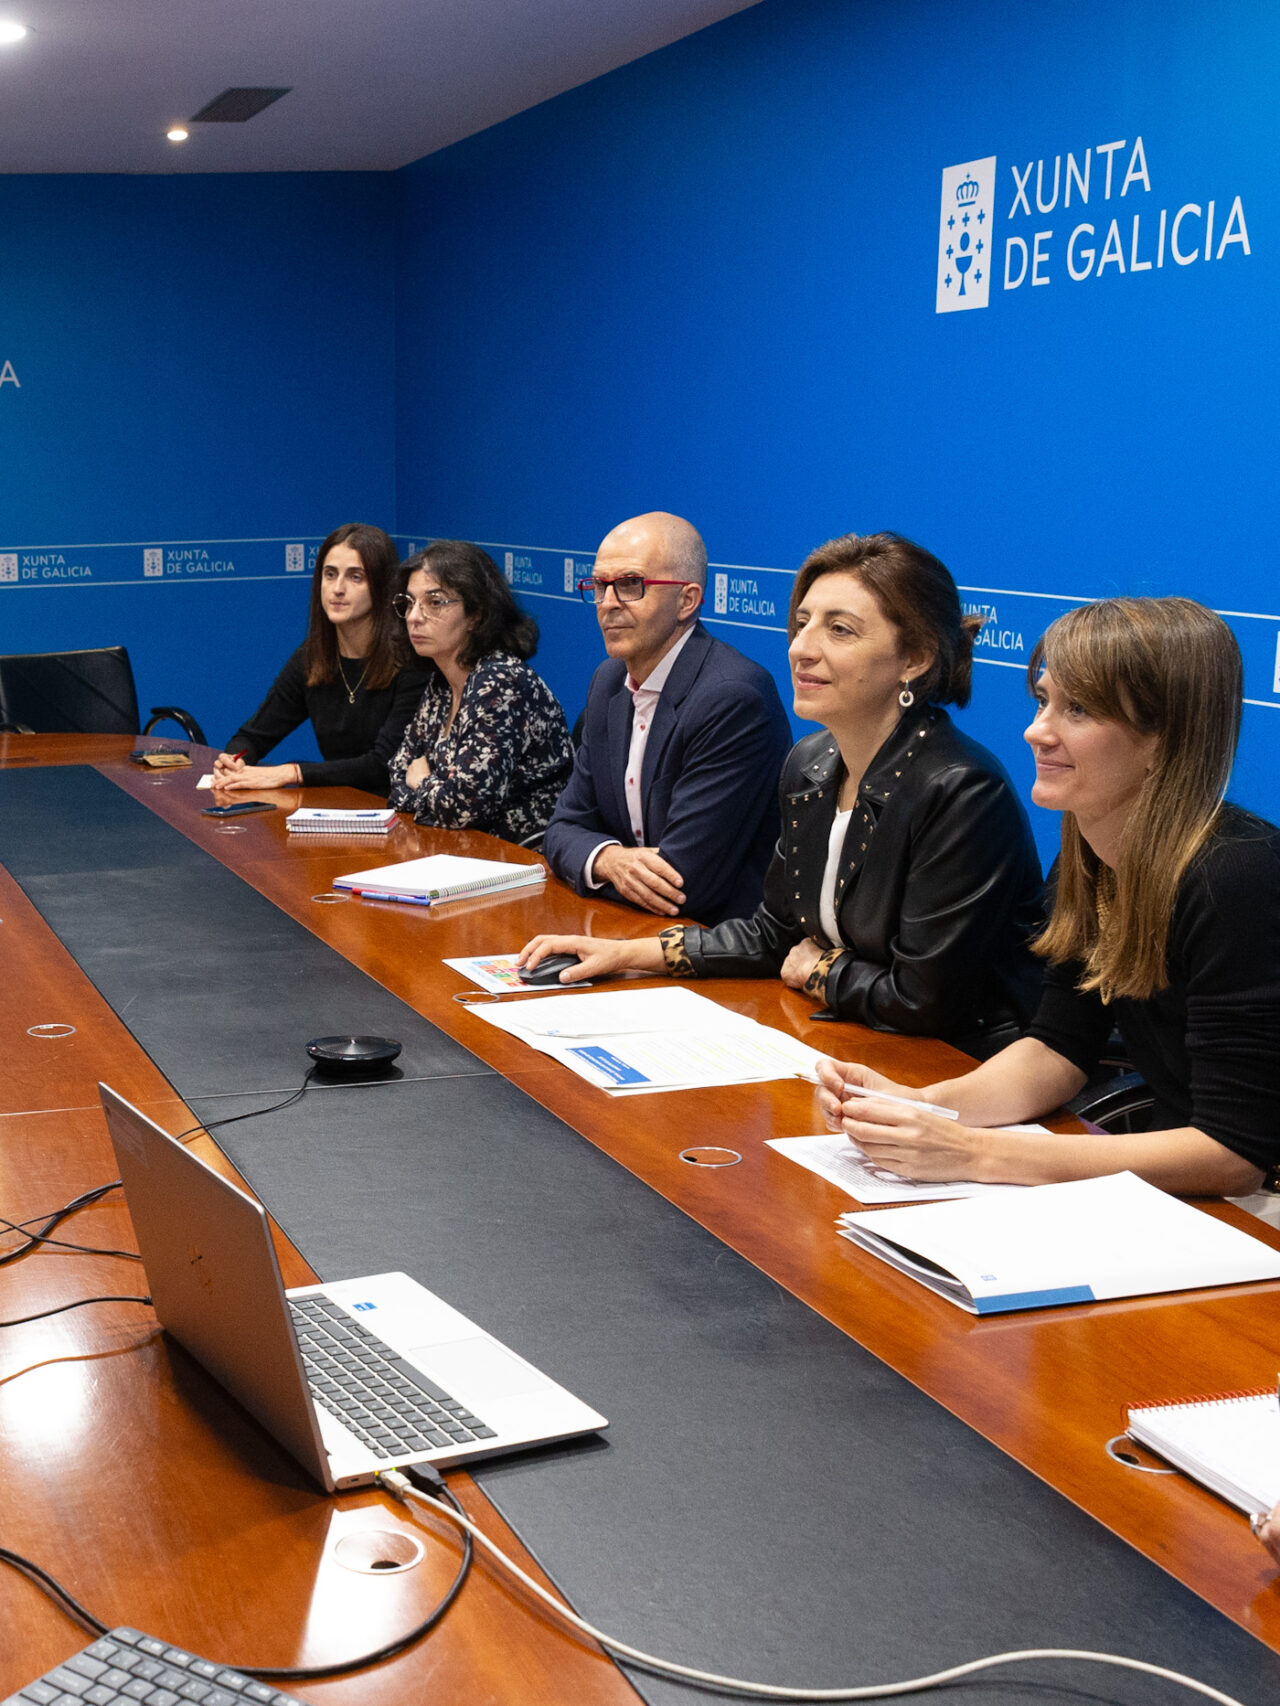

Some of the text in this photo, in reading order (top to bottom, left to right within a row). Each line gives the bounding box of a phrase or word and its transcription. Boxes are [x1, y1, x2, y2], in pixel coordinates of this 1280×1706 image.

[1008, 136, 1151, 219] XUNTA
[1004, 195, 1251, 290] DE GALICIA
[21, 554, 66, 566] XUNTA
[166, 549, 209, 561] XUNTA
[21, 566, 92, 579] DE GALICIA
[166, 560, 235, 574] DE GALICIA
[575, 563, 593, 577] XUNT
[729, 578, 759, 596] XUNTA
[729, 596, 776, 616] DE GALICIA
